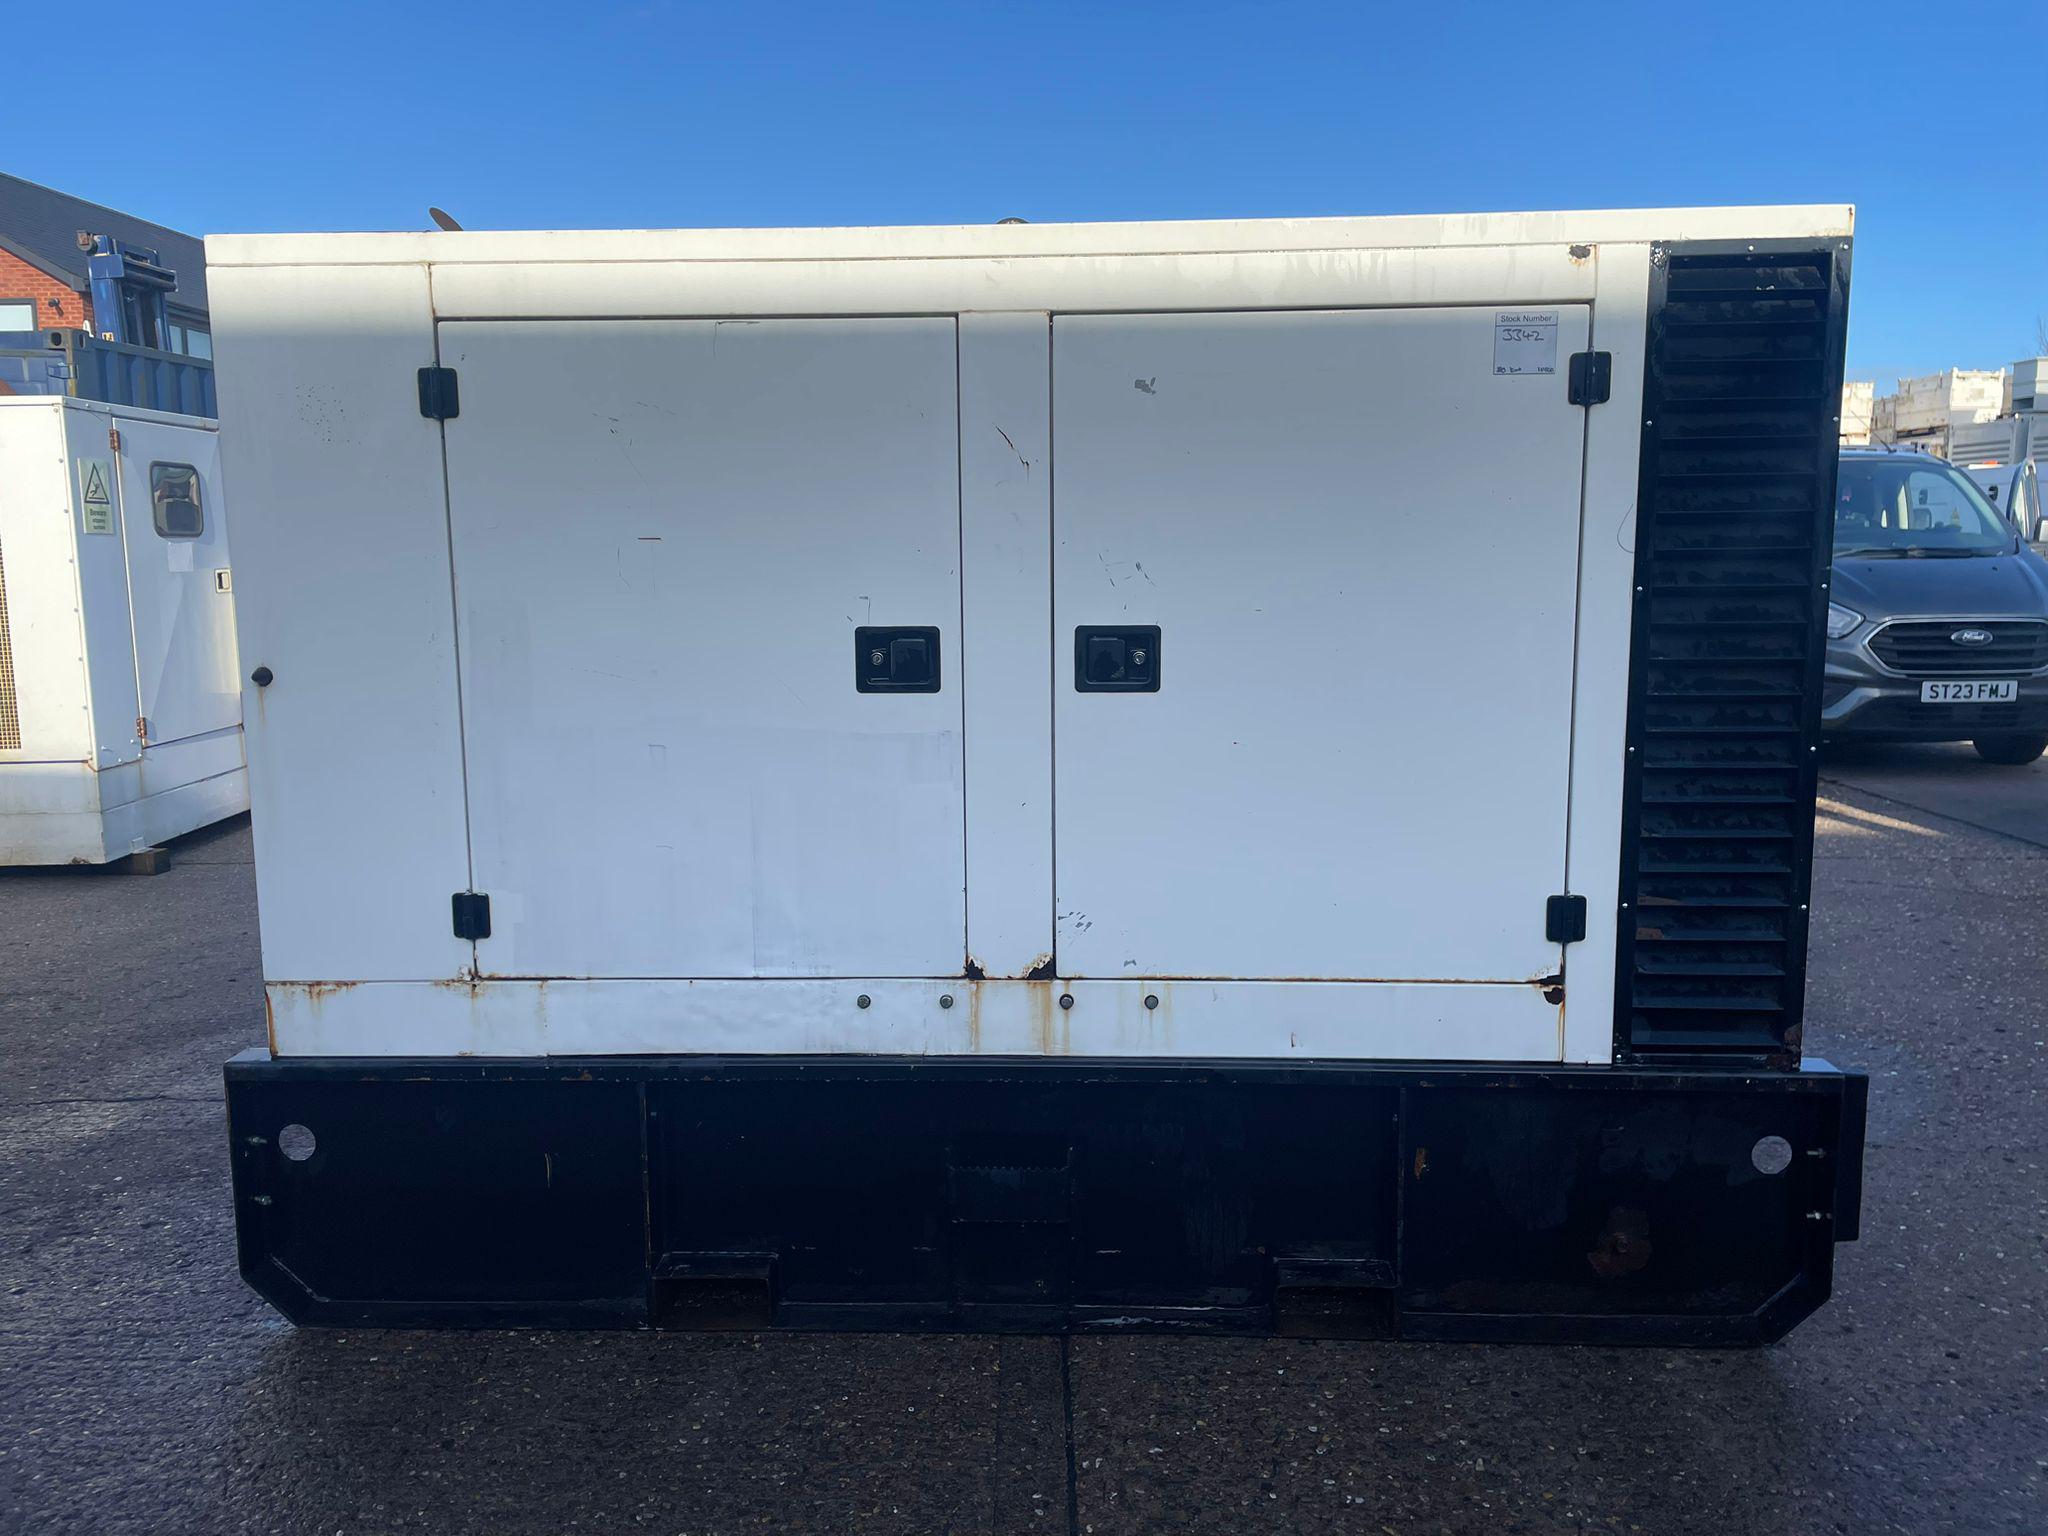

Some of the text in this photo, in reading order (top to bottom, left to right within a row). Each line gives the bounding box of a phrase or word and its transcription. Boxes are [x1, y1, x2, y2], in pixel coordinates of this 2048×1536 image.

[1501, 314, 1553, 323] Stock Number
[1502, 328, 1545, 342] 3342
[1929, 684, 2010, 699] ST23 FMJ
